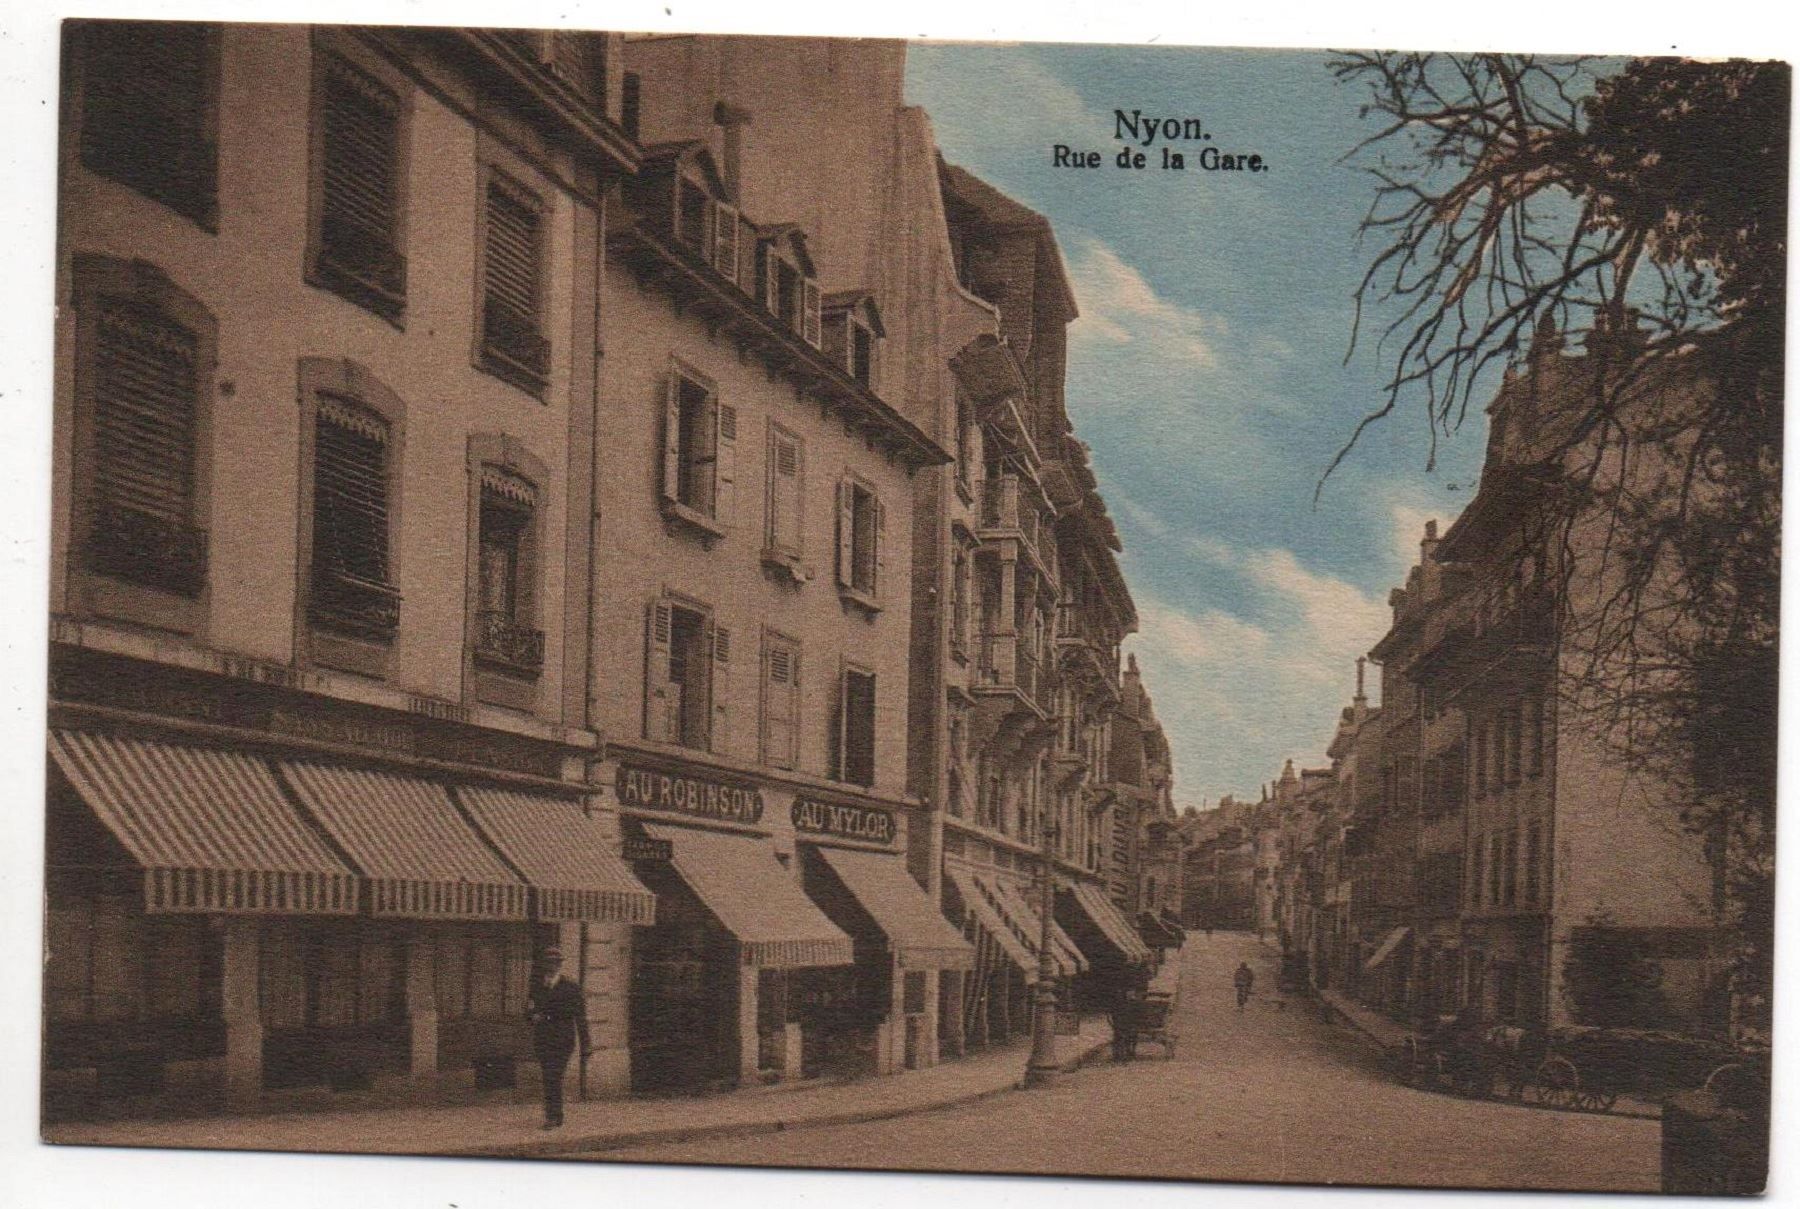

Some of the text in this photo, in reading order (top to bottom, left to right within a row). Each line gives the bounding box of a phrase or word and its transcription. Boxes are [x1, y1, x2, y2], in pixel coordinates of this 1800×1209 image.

[625, 770, 755, 818] AU ROBINSON
[798, 801, 890, 839] AU MYLOR
